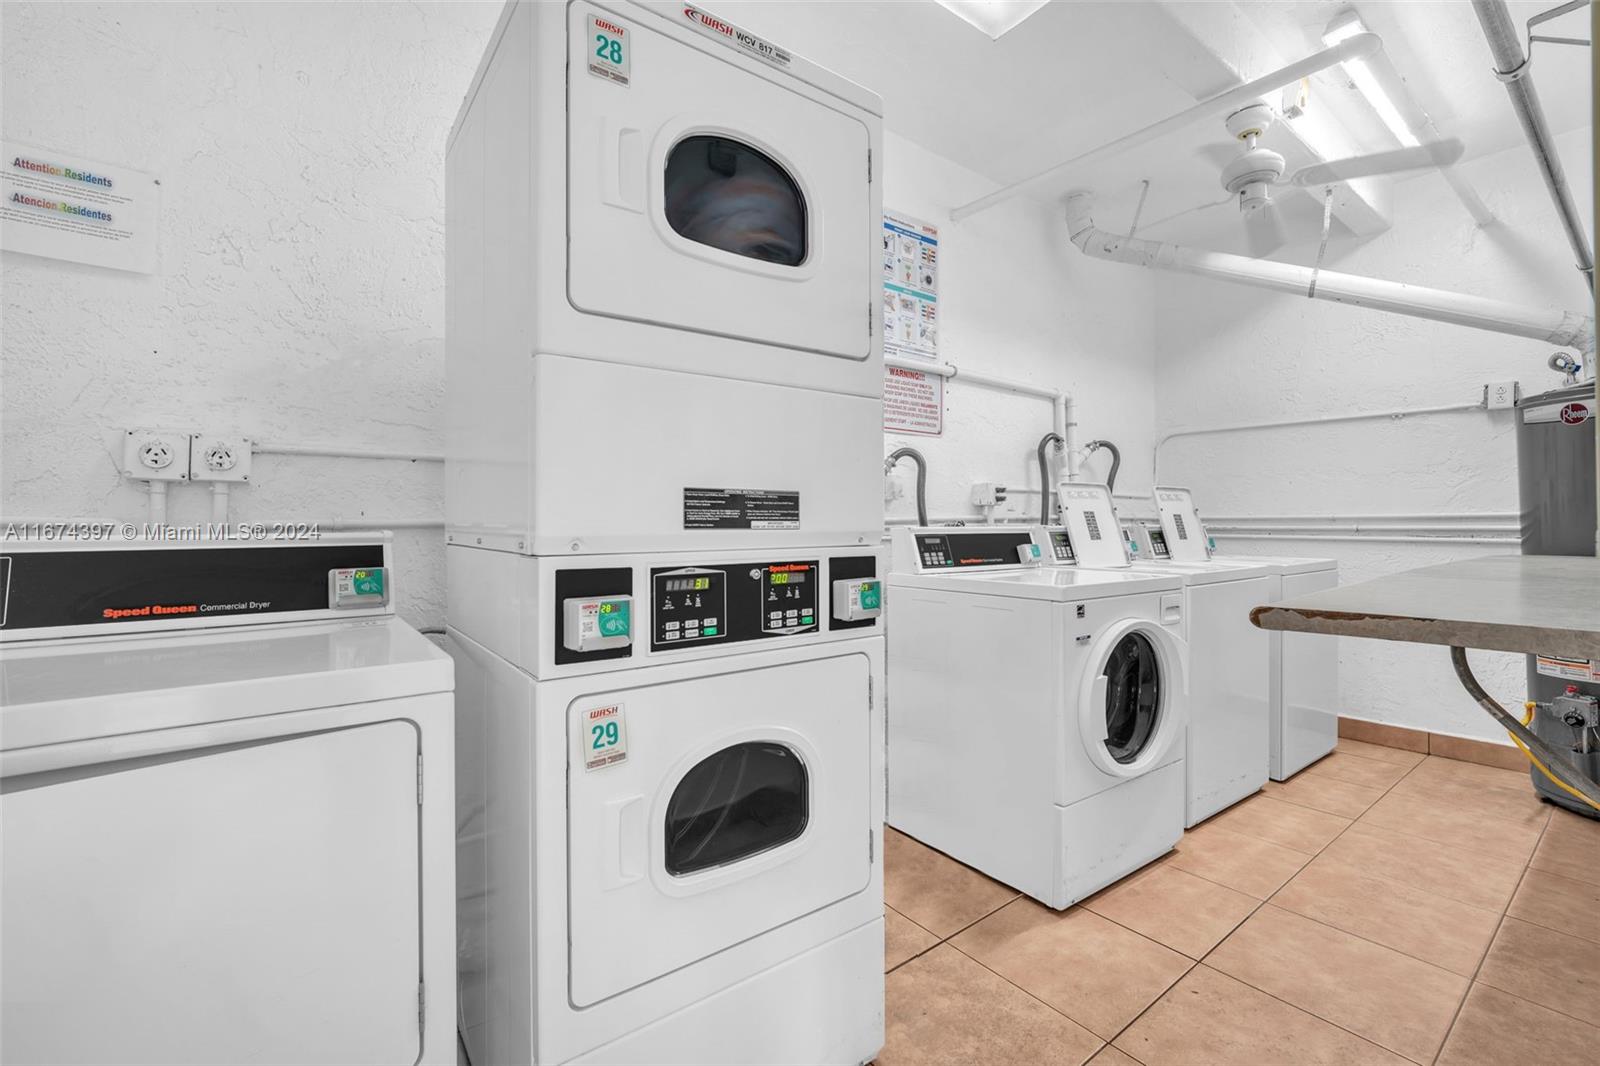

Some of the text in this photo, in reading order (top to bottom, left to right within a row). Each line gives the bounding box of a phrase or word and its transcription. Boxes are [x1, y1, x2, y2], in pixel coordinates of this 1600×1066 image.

[595, 18, 624, 36] WASH
[701, 15, 773, 54] WASH WCV 817
[596, 34, 622, 64] 28
[13, 157, 62, 176] Attention
[64, 168, 112, 188] Residents
[13, 192, 112, 222] Atencion Residentes
[103, 602, 271, 619] Speed Queen Commercial Dryer
[600, 604, 611, 614] 28
[590, 706, 618, 719] WASH
[592, 721, 619, 750] 29
